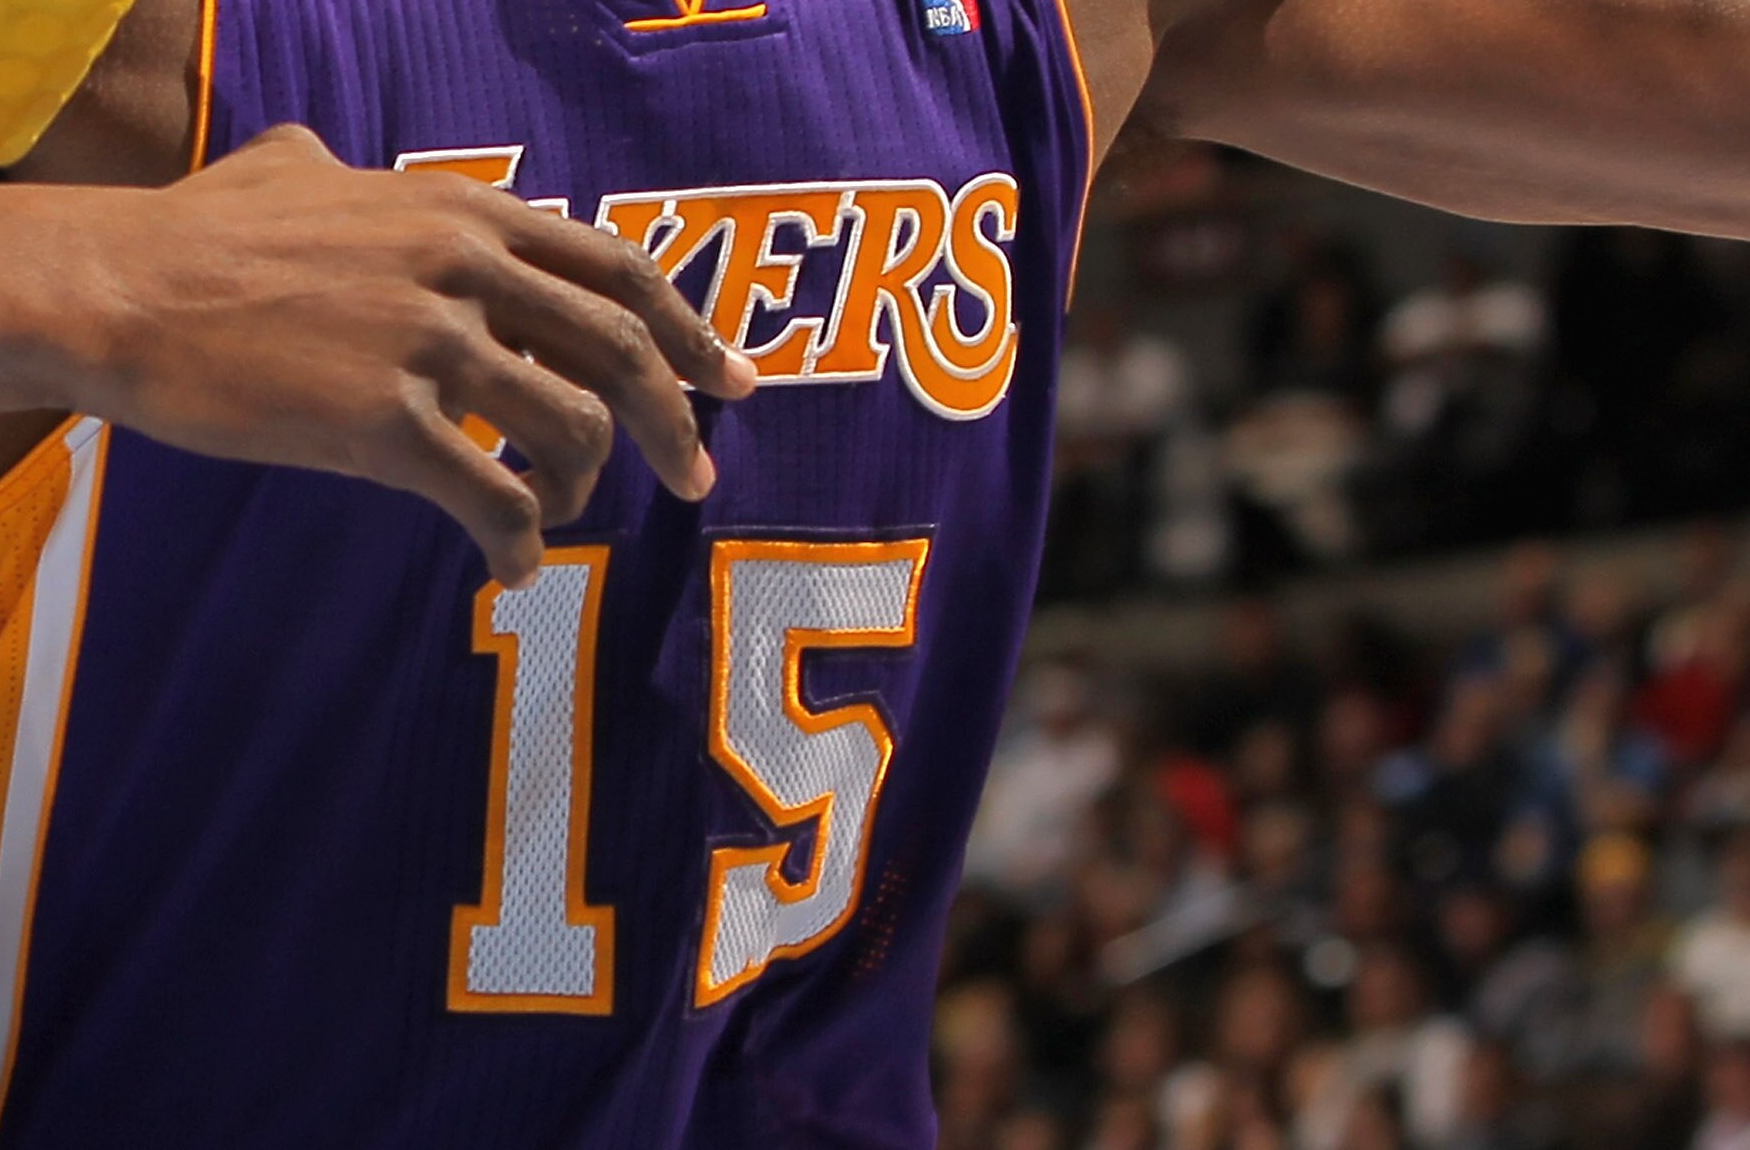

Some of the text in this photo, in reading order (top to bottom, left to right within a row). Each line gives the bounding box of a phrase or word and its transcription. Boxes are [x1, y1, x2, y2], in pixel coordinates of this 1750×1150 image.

[925, 4, 965, 30] NBA
[393, 144, 1018, 458] KERS
[446, 528, 934, 1017] 15
